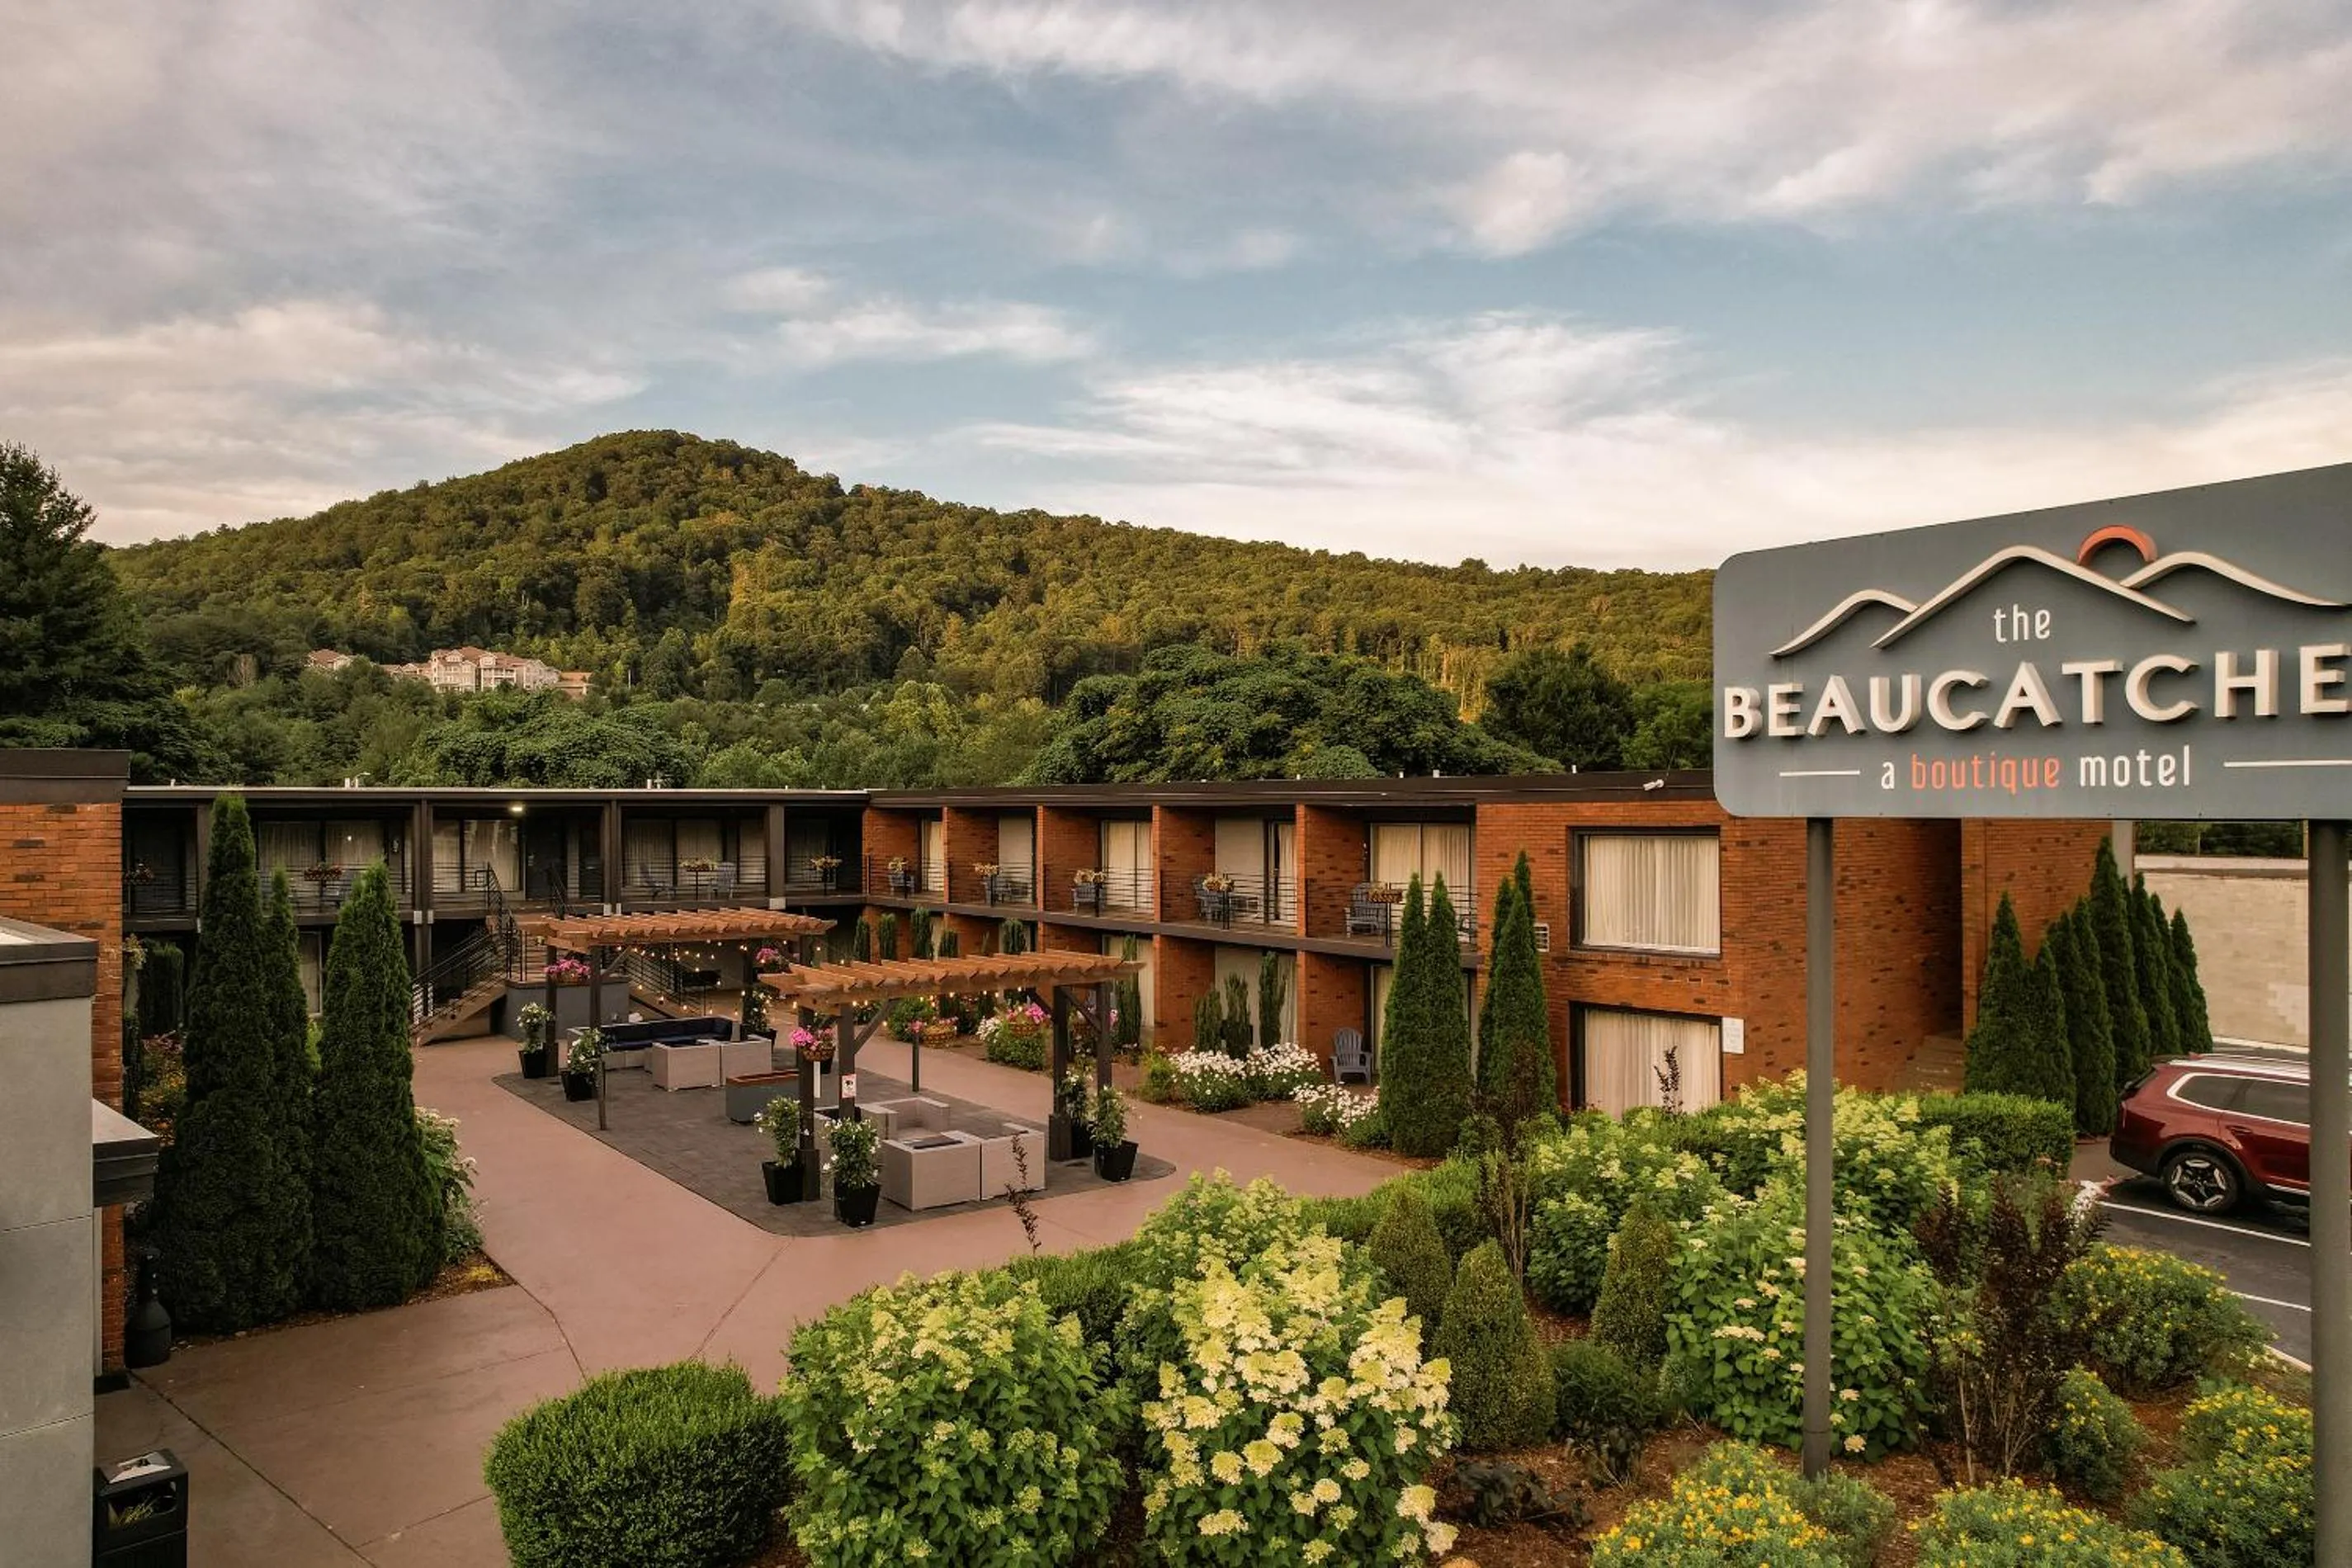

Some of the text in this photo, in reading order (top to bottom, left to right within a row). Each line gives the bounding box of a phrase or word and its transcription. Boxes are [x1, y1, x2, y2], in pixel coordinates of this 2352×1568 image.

[1993, 603, 2051, 643] the
[1723, 643, 2352, 739] BEAUCATCHE
[1881, 744, 2190, 795] a boutique motel
